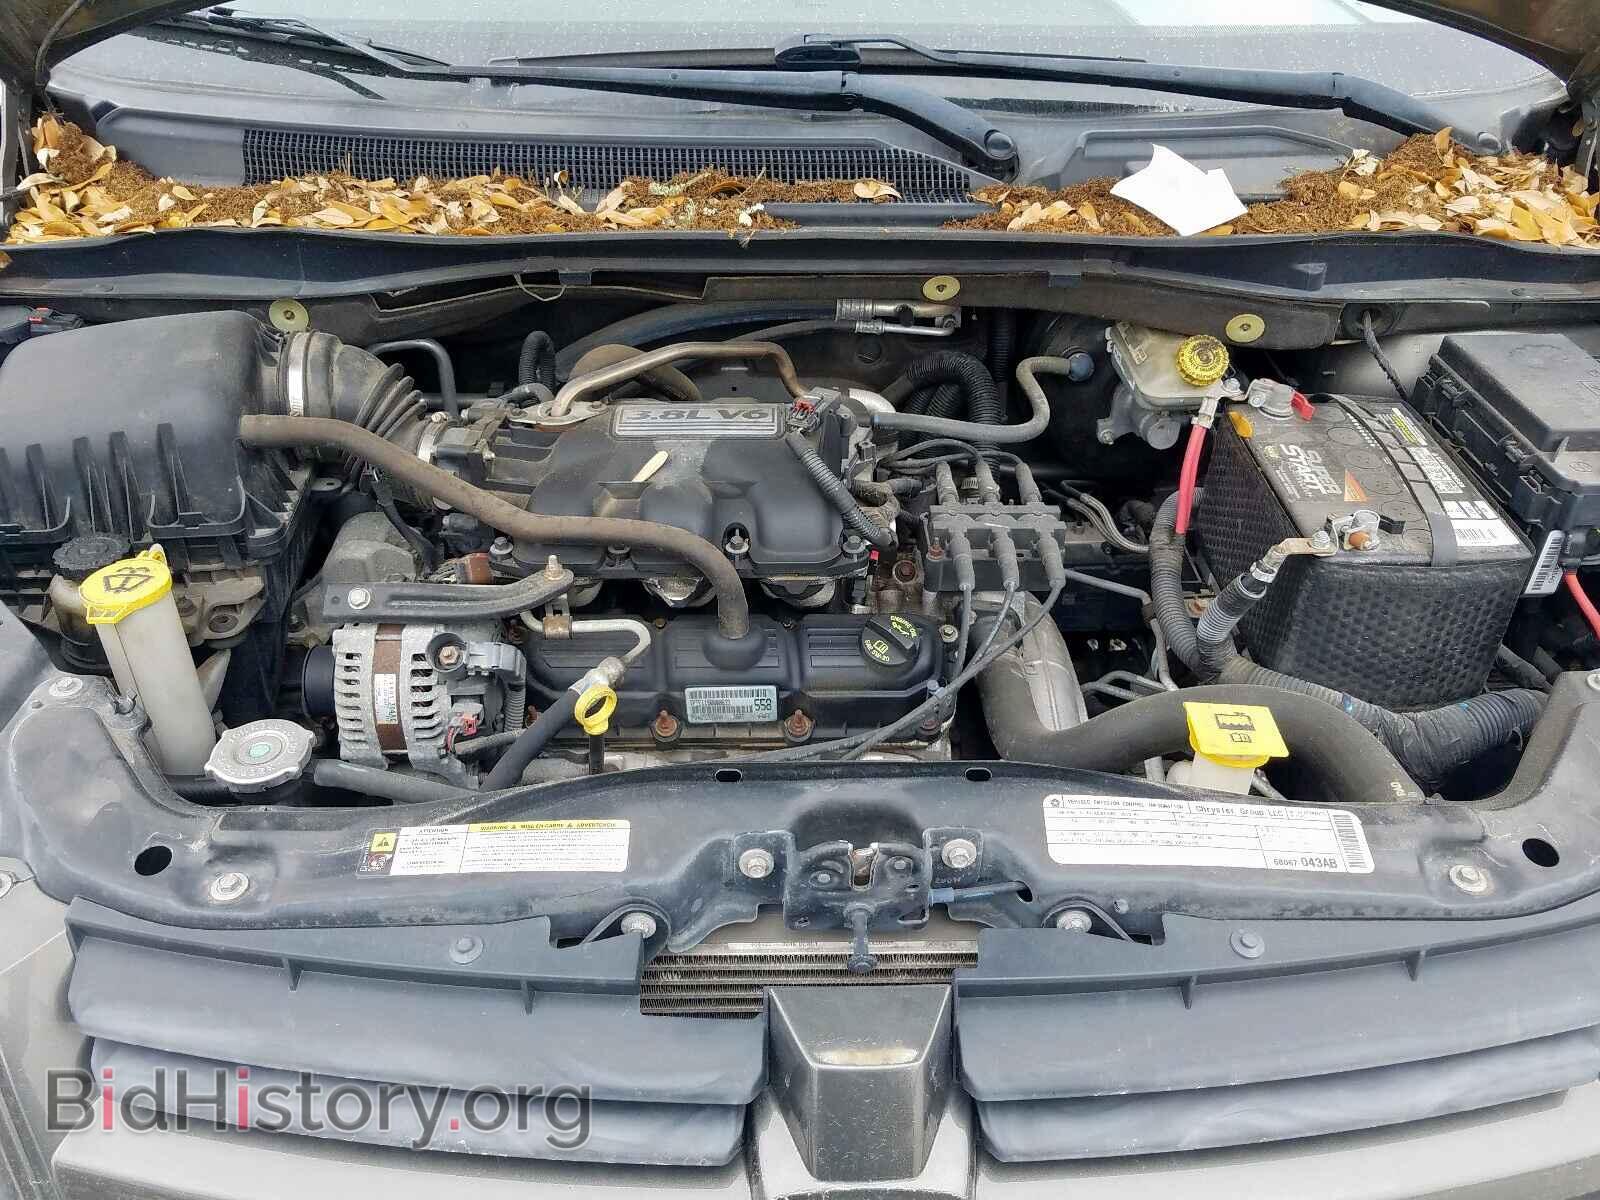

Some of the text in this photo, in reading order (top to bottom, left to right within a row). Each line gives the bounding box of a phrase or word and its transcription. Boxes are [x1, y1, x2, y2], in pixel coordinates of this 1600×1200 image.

[715, 408, 768, 420] V6
[1280, 443, 1328, 495] START
[1305, 449, 1342, 495] SUPER
[1300, 856, 1338, 869] 043AB
